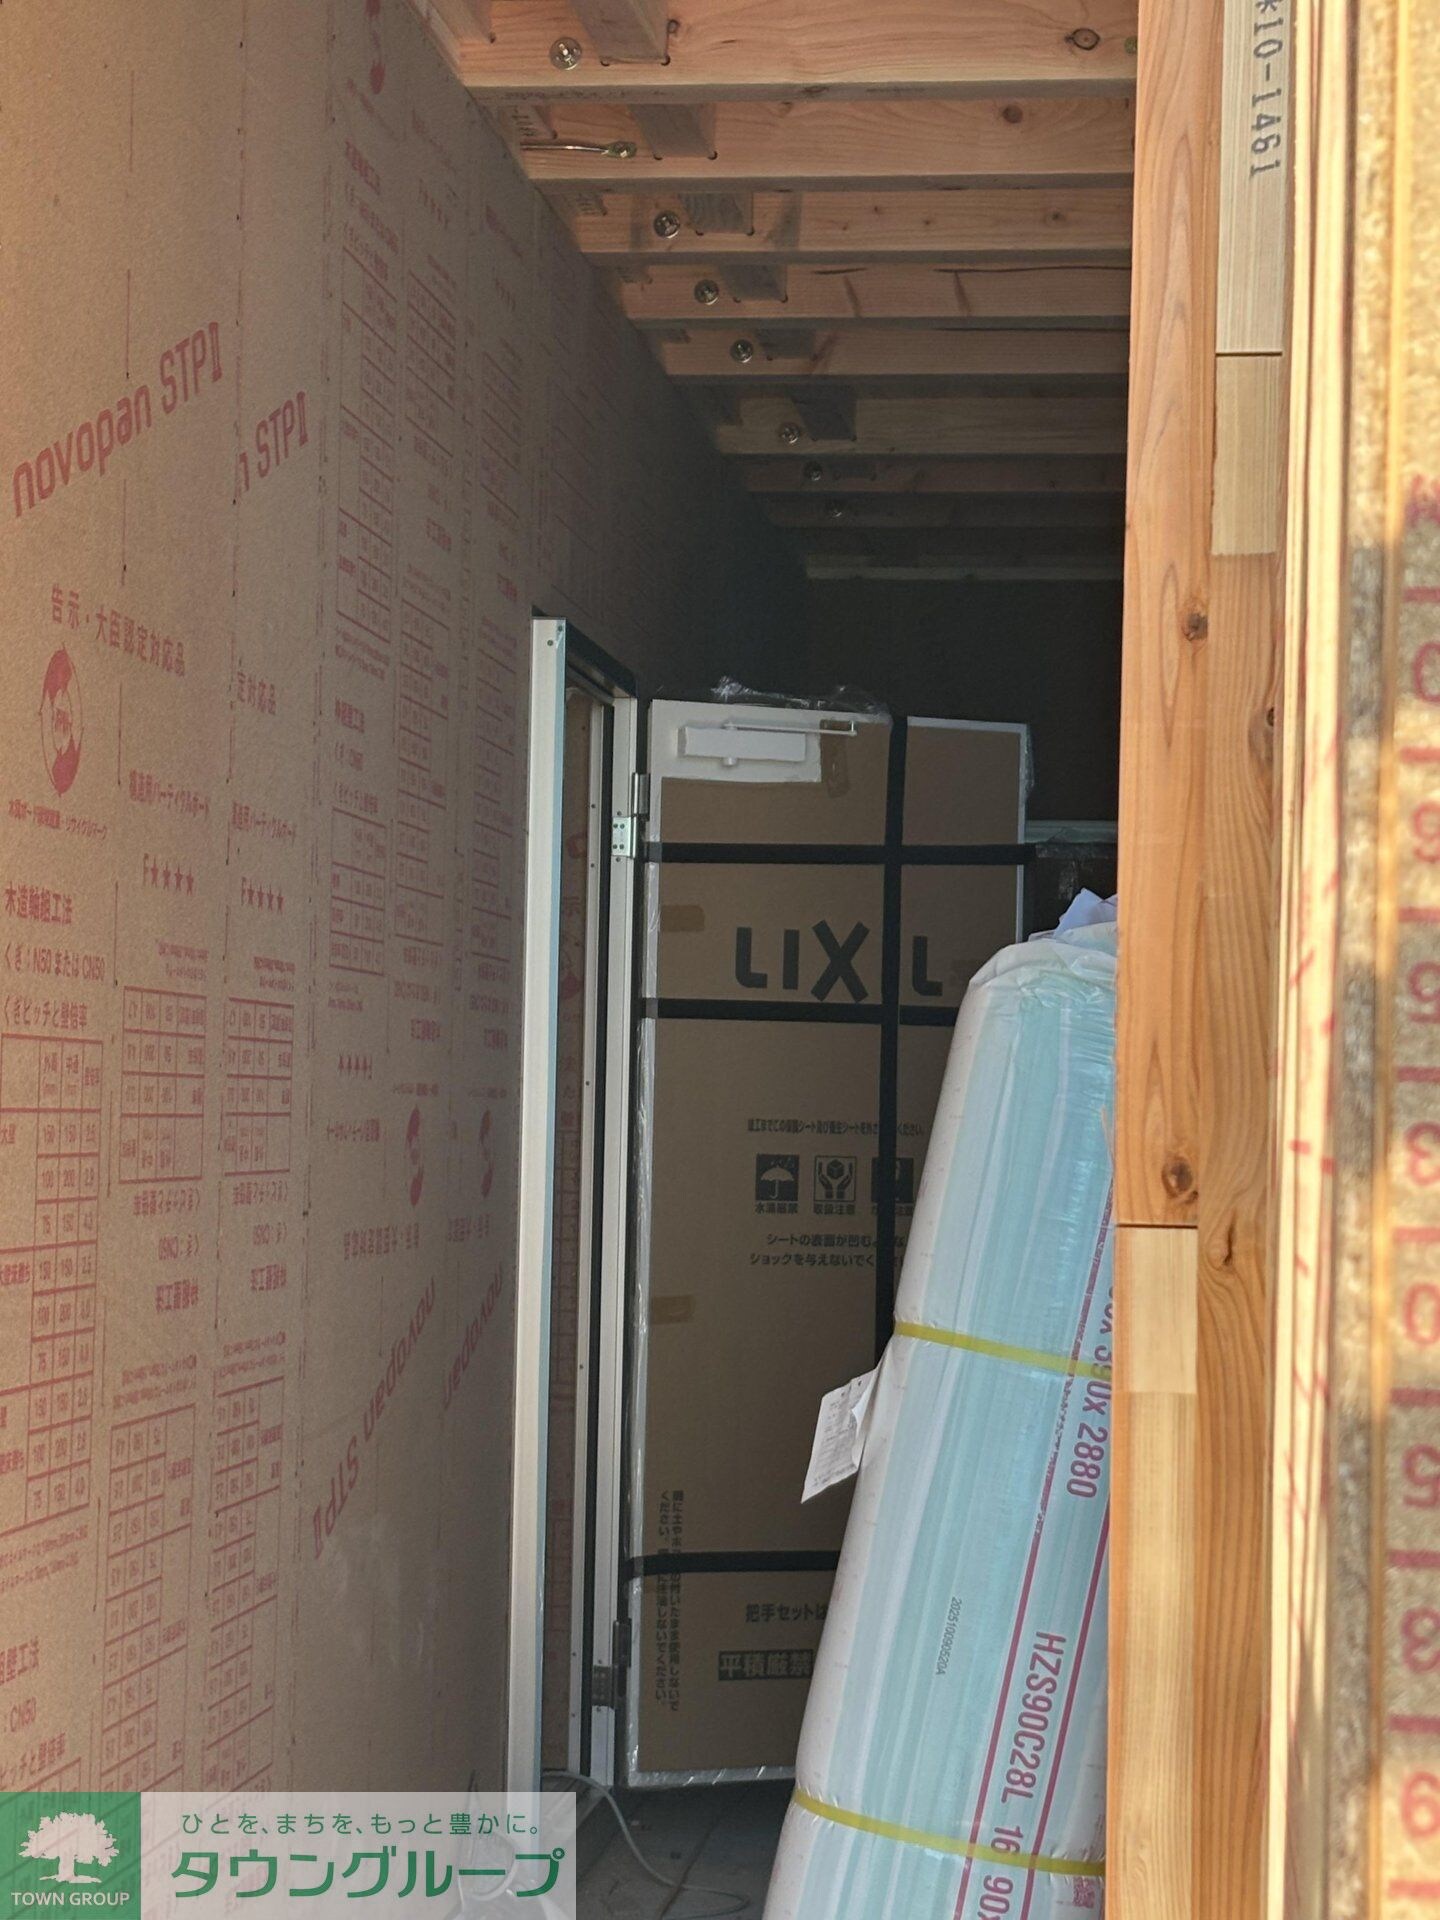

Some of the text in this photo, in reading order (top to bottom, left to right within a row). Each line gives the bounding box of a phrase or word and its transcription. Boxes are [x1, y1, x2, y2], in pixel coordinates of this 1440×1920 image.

[12, 384, 151, 518] novopan
[735, 919, 943, 1002] LIXL
[1066, 1421, 1109, 1499] 2880
[1000, 1630, 1067, 1804] HZS90C28L
